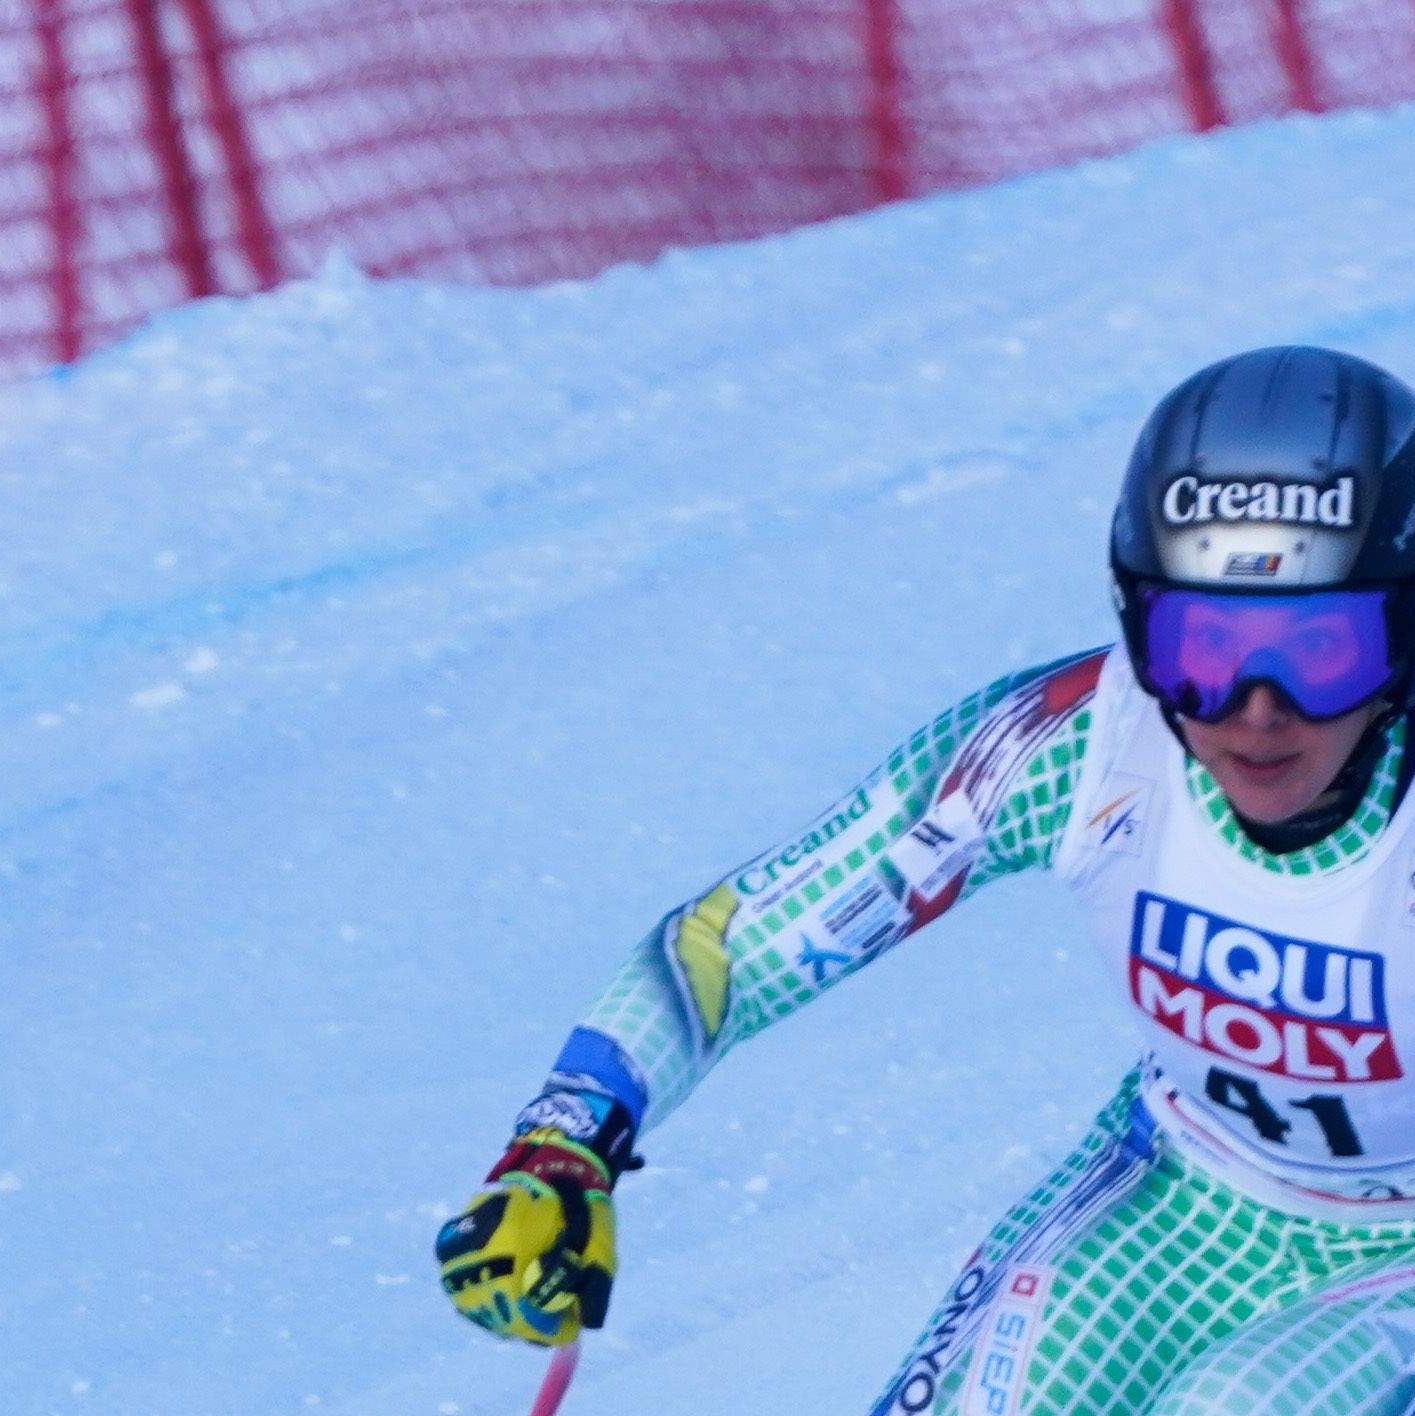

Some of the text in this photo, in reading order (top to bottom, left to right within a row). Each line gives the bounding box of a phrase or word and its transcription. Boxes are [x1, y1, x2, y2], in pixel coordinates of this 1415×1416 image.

[1164, 475, 1354, 527] Creand
[737, 788, 871, 895] Creand
[1139, 898, 1375, 1022] LIQUI
[1138, 967, 1387, 1080] MOLY
[1206, 1066, 1363, 1156] 41
